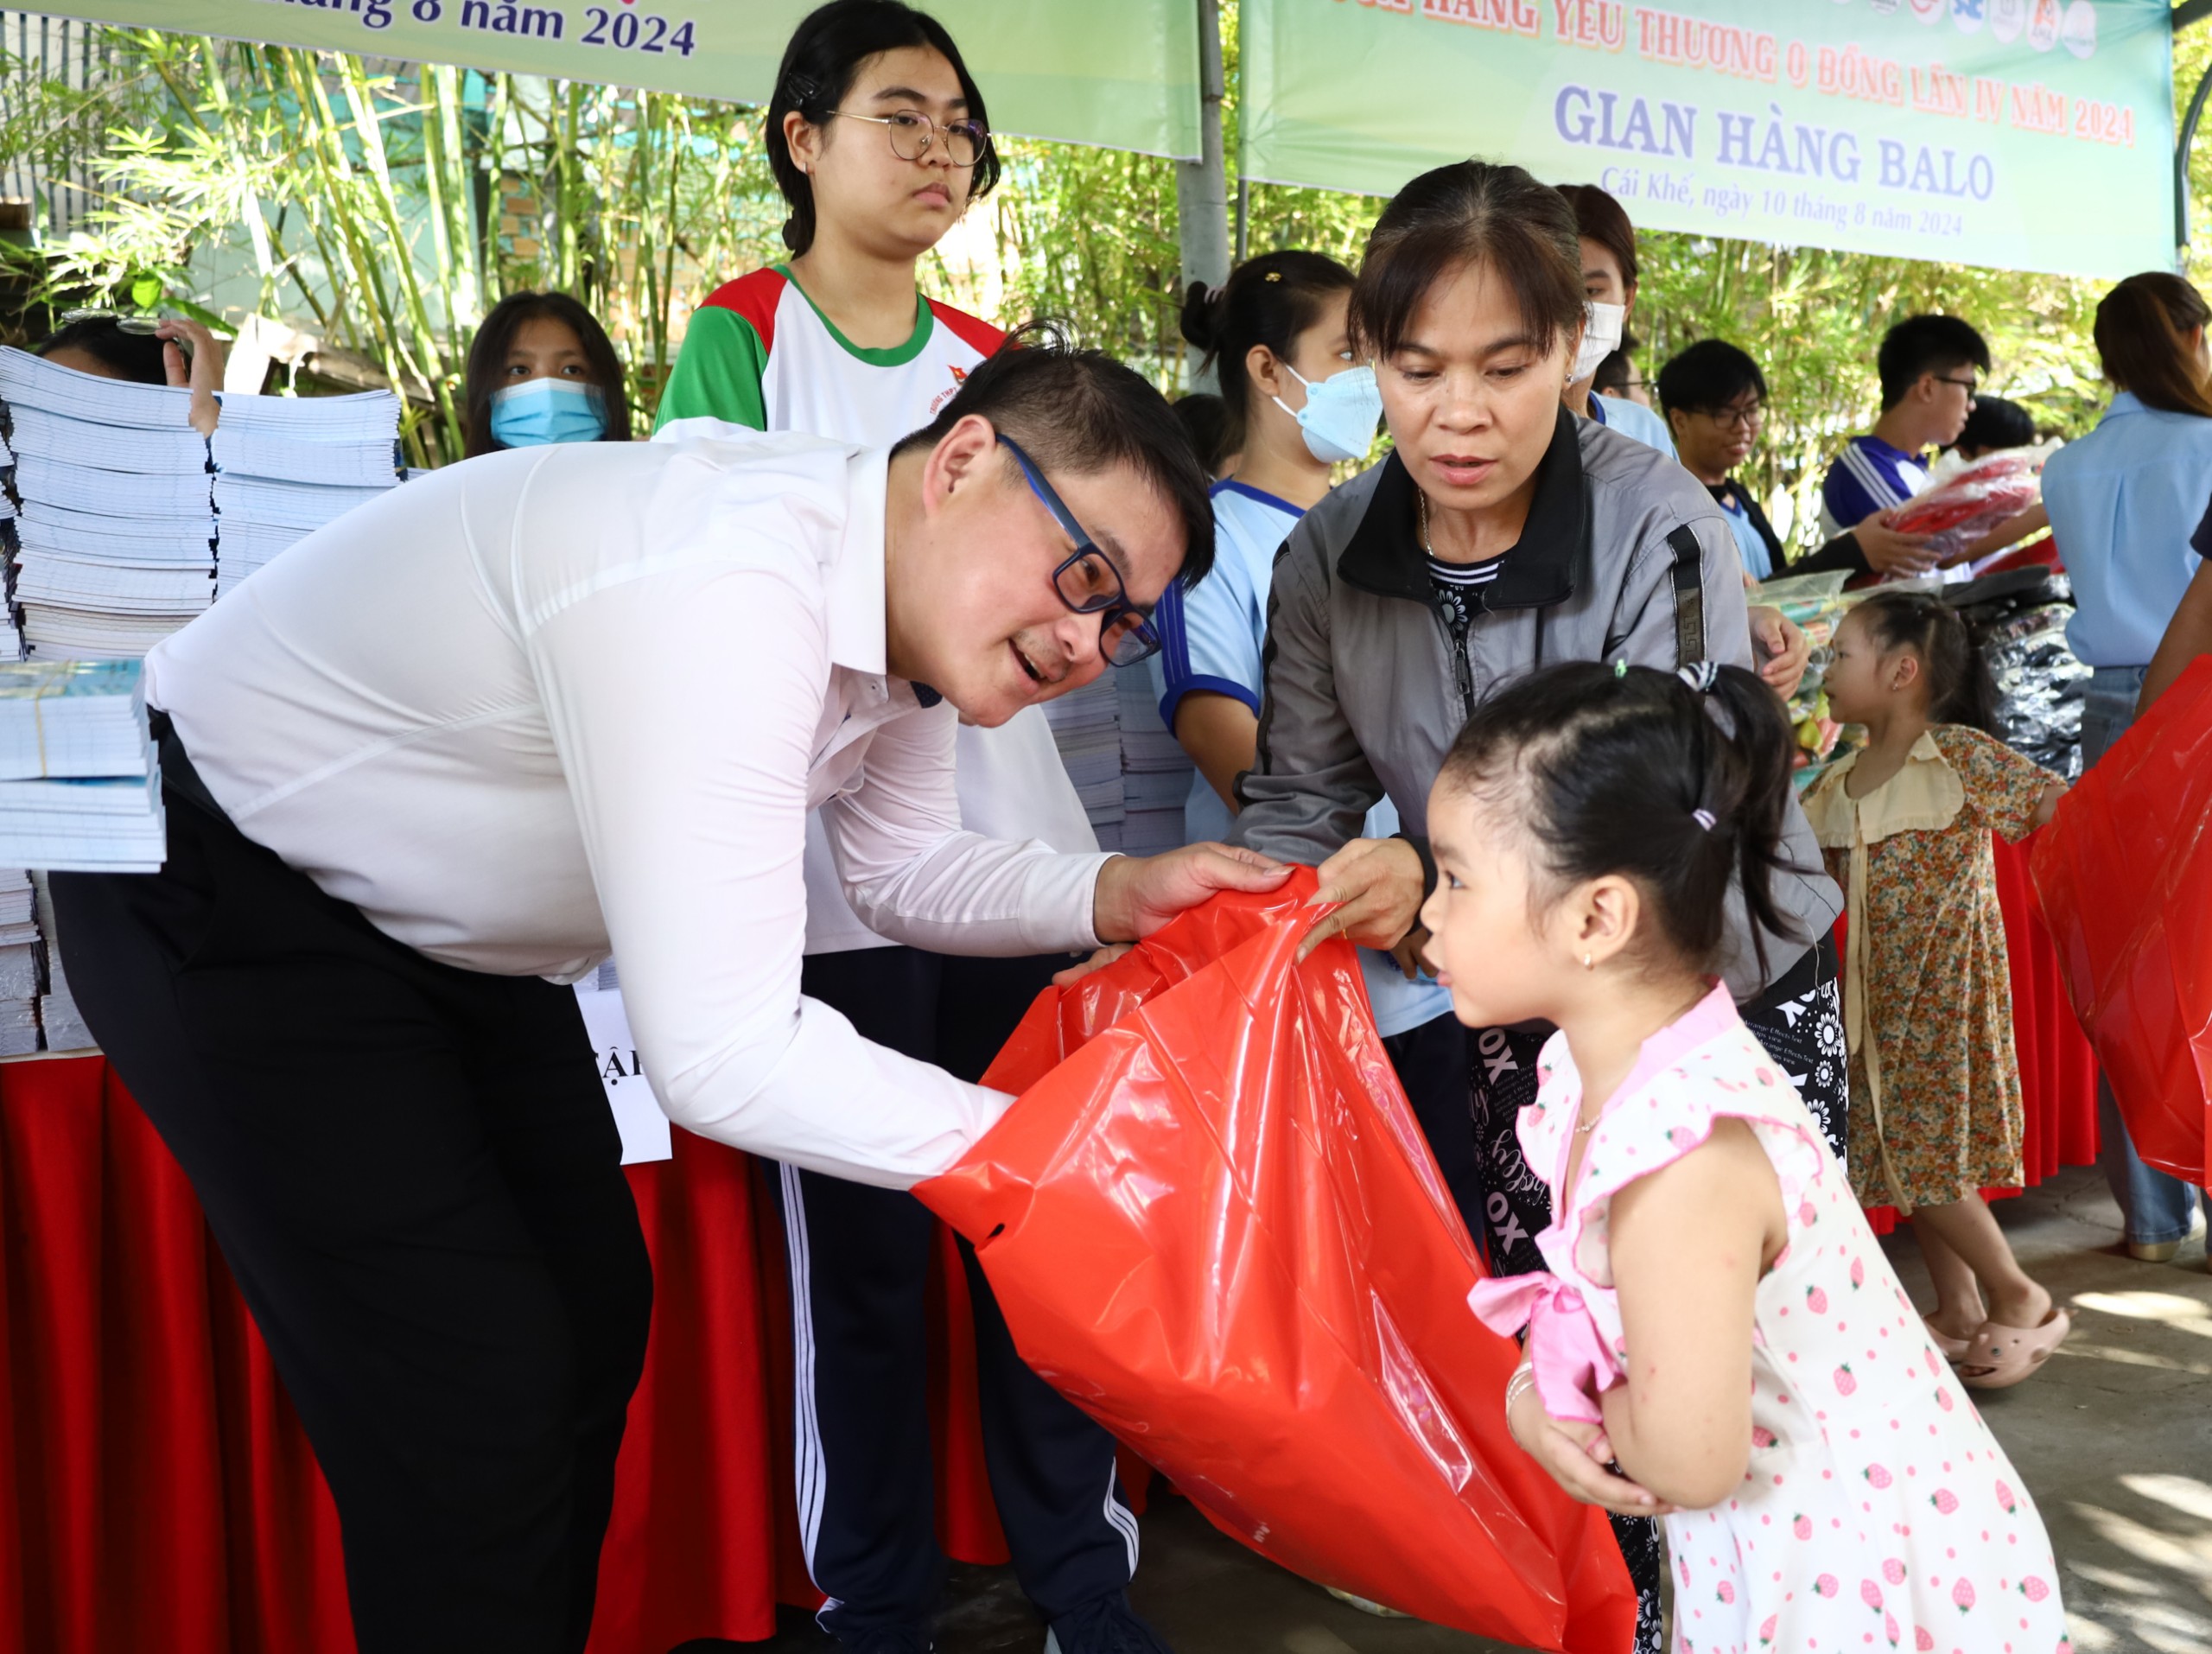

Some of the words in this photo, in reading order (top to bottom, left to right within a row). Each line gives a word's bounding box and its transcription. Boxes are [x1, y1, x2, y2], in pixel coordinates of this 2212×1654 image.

[461, 0, 564, 39] năm
[581, 8, 695, 56] 2024
[1634, 8, 1776, 78] THƯƠNG
[1975, 78, 2005, 118] IV
[2011, 80, 2066, 130] NĂM
[2075, 98, 2133, 143] 2024
[1554, 85, 1698, 159] GIAN
[1716, 102, 1861, 183] HÀNG
[1878, 138, 1994, 201] BALO
[1601, 167, 1640, 198] Cái
[1647, 172, 1696, 213] Khế,
[1702, 182, 1753, 219] ngày
[1763, 189, 1787, 216] 10
[1793, 192, 1848, 232] tháng
[1853, 201, 1867, 226] 8
[1872, 207, 1912, 231] năm
[1918, 209, 1963, 237] 2024
